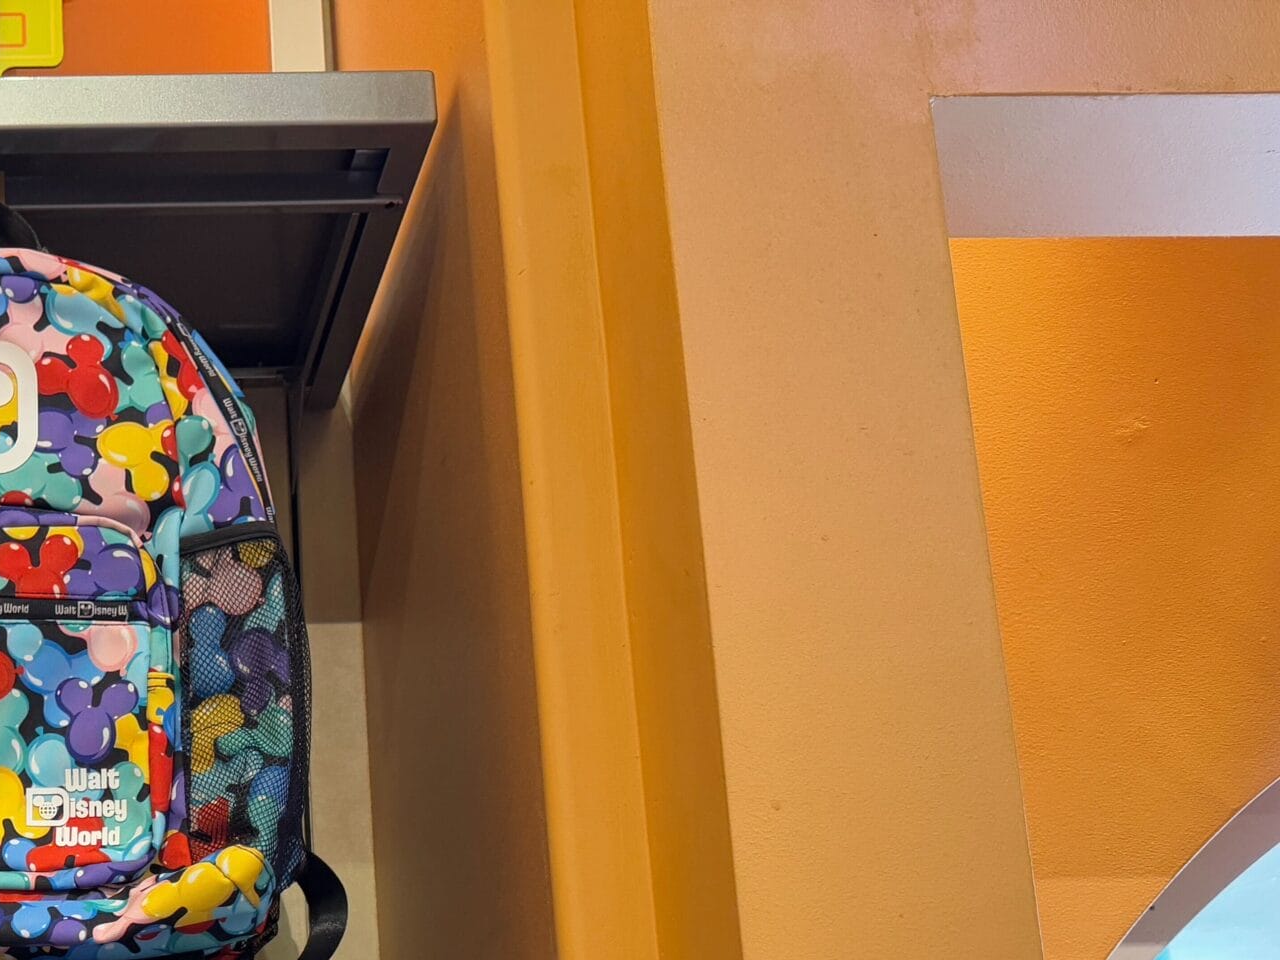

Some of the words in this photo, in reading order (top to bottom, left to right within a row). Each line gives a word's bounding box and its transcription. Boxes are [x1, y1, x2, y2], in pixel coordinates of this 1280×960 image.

[222, 397, 238, 421] Walt
[230, 418, 254, 459] Disney
[248, 456, 263, 482] World
[3, 602, 30, 615] World
[55, 604, 77, 616] Walt
[76, 600, 118, 618] Disney
[64, 767, 120, 792] Walt
[25, 786, 128, 828] Disney
[54, 826, 121, 847] World
